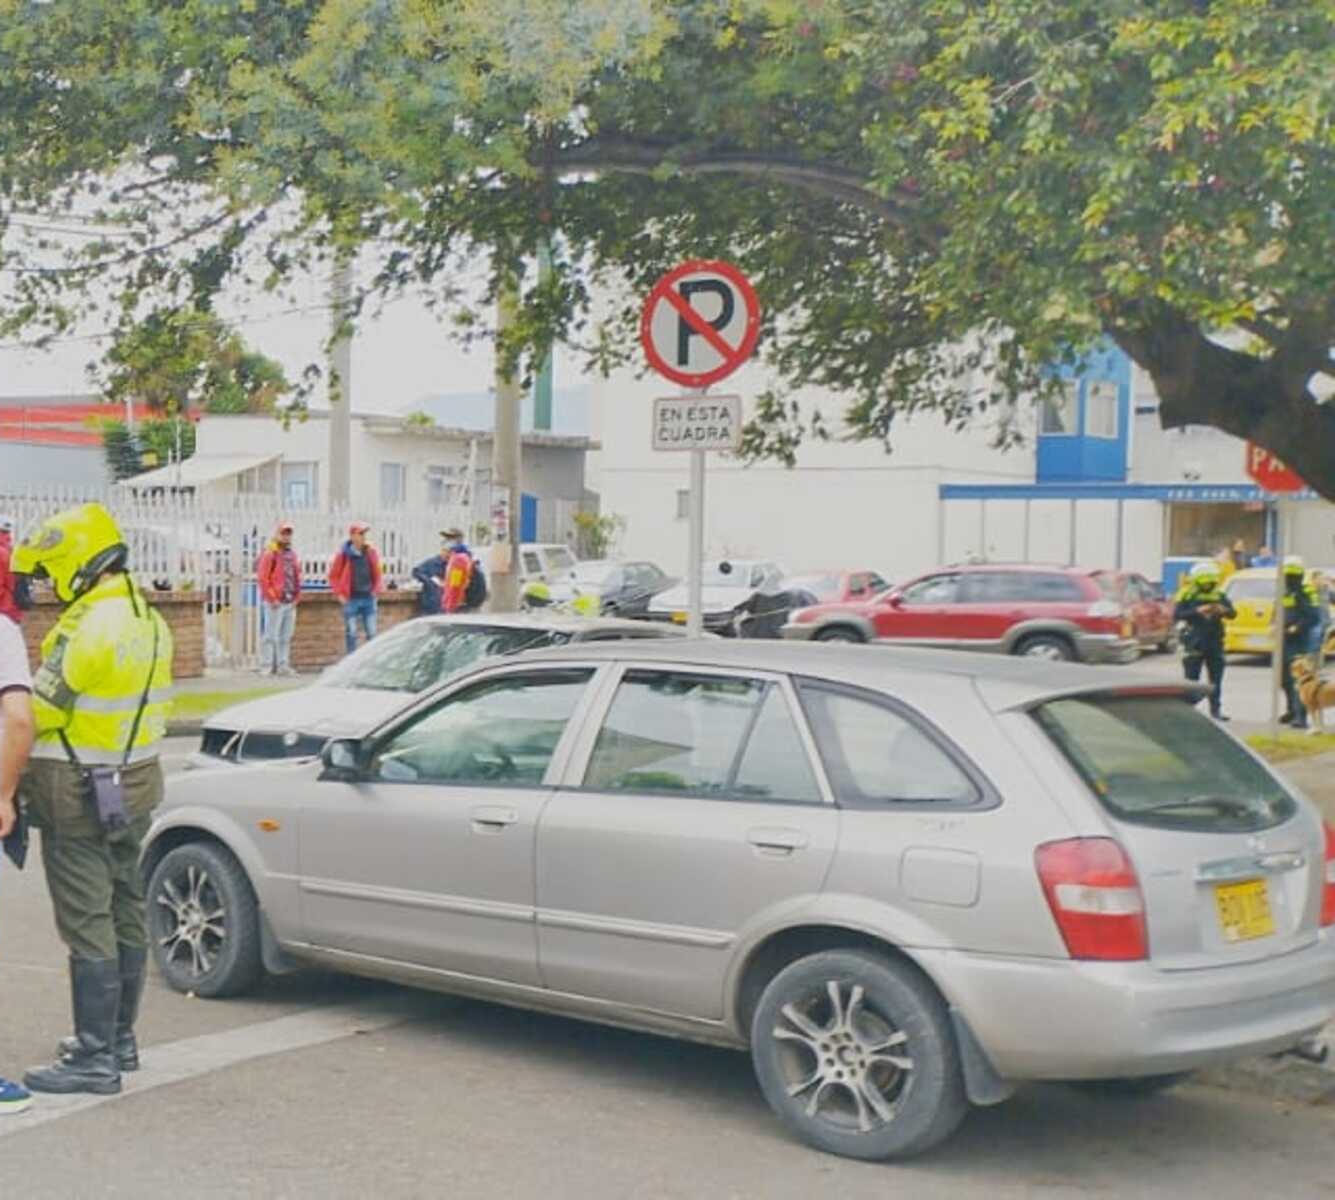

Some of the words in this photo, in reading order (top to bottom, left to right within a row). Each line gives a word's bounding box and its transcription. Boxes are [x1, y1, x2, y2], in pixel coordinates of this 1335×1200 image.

[677, 279, 735, 366] P
[659, 407, 682, 422] EN
[687, 406, 731, 421] ESTA
[658, 426, 731, 442] CUADRA
[1251, 446, 1287, 473] PA
